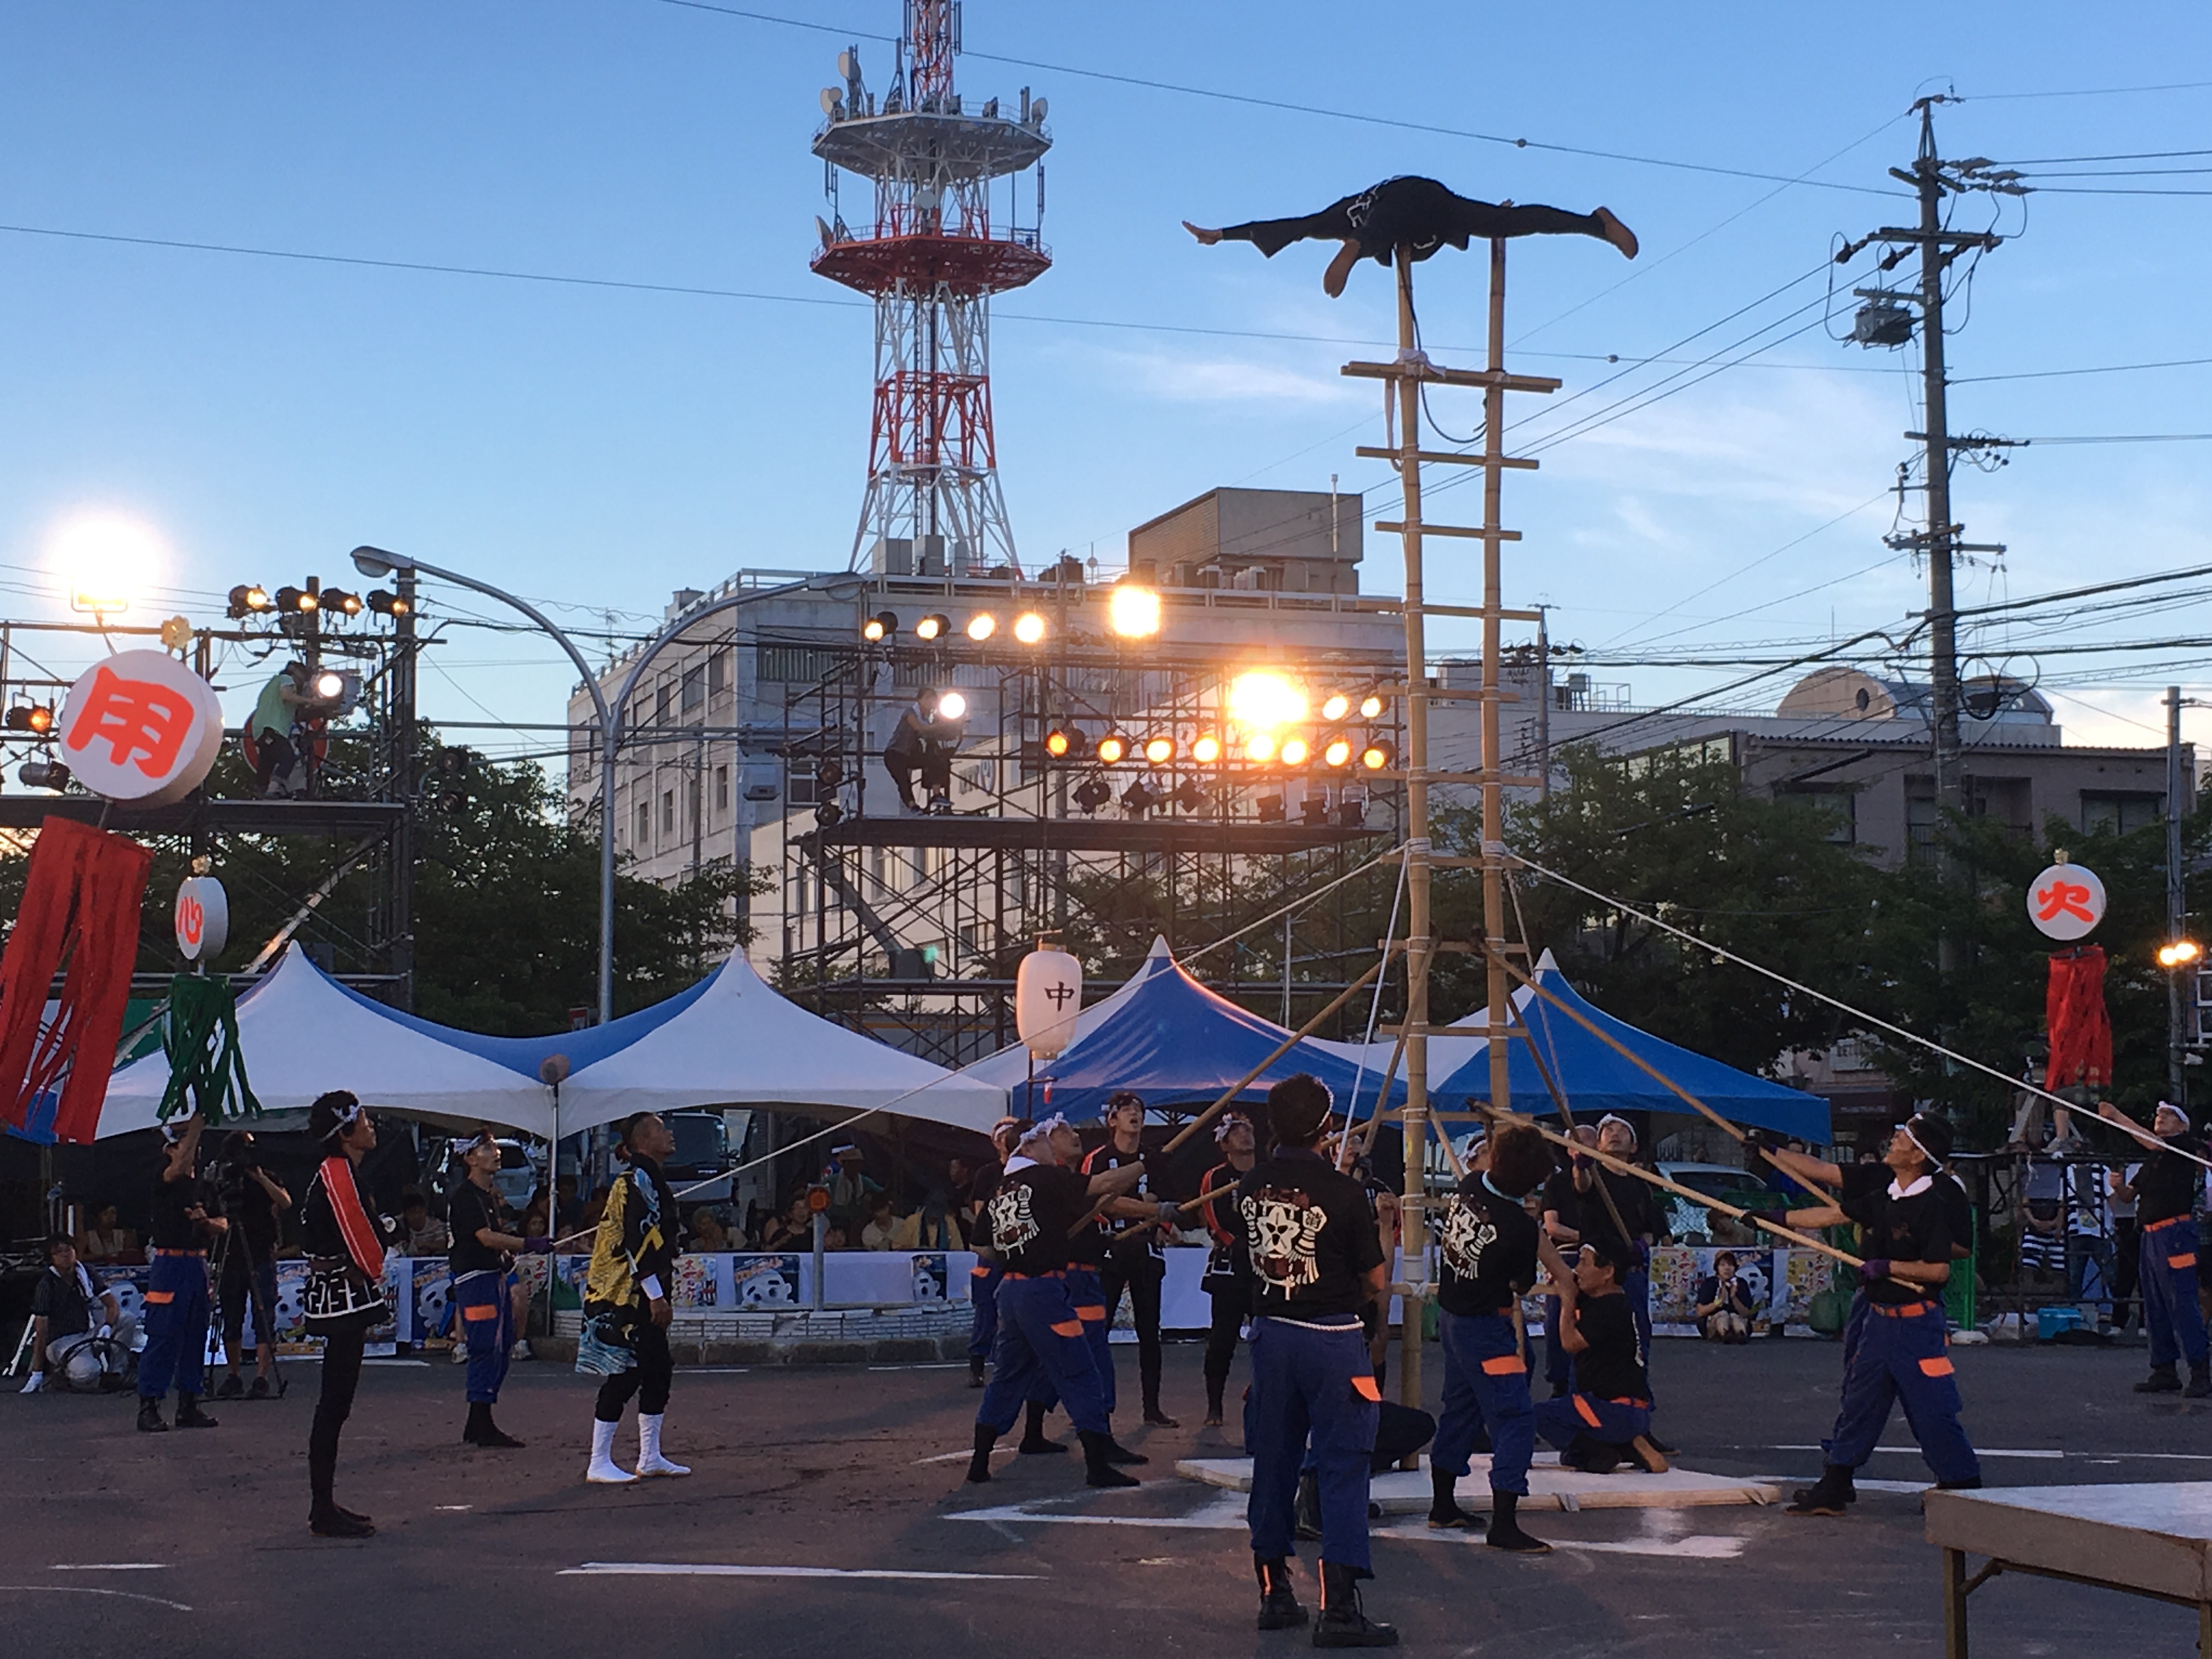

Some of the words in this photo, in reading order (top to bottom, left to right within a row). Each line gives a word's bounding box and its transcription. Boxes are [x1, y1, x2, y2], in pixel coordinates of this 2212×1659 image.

[67, 666, 194, 778] 用
[176, 896, 203, 945] 心
[2037, 879, 2095, 923] 火
[1044, 981, 1075, 1012] 中
